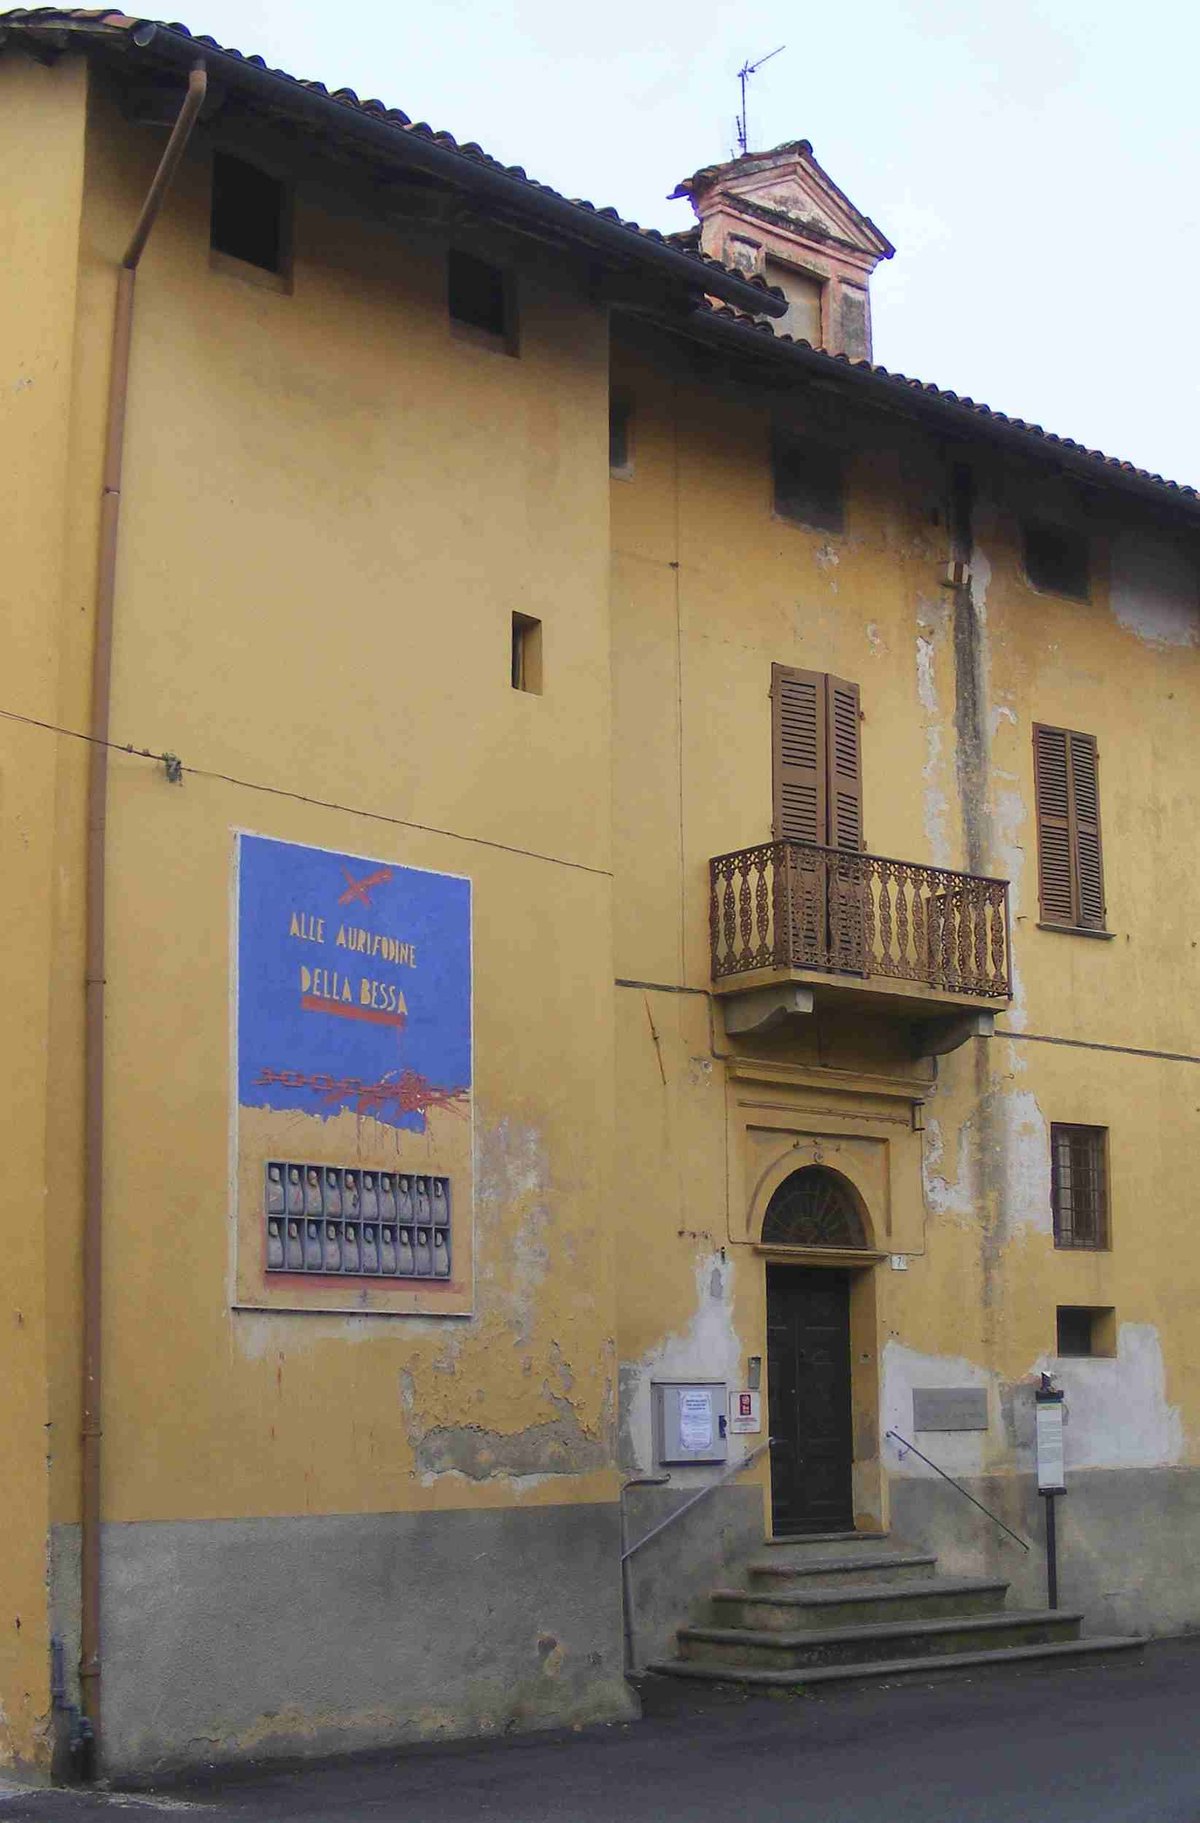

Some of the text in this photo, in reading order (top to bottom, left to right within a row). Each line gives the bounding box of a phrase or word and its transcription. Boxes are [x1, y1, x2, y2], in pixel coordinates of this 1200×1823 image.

[290, 912, 417, 969] ALLE AURIFODINE
[301, 965, 408, 1016] DELLA BESSA
